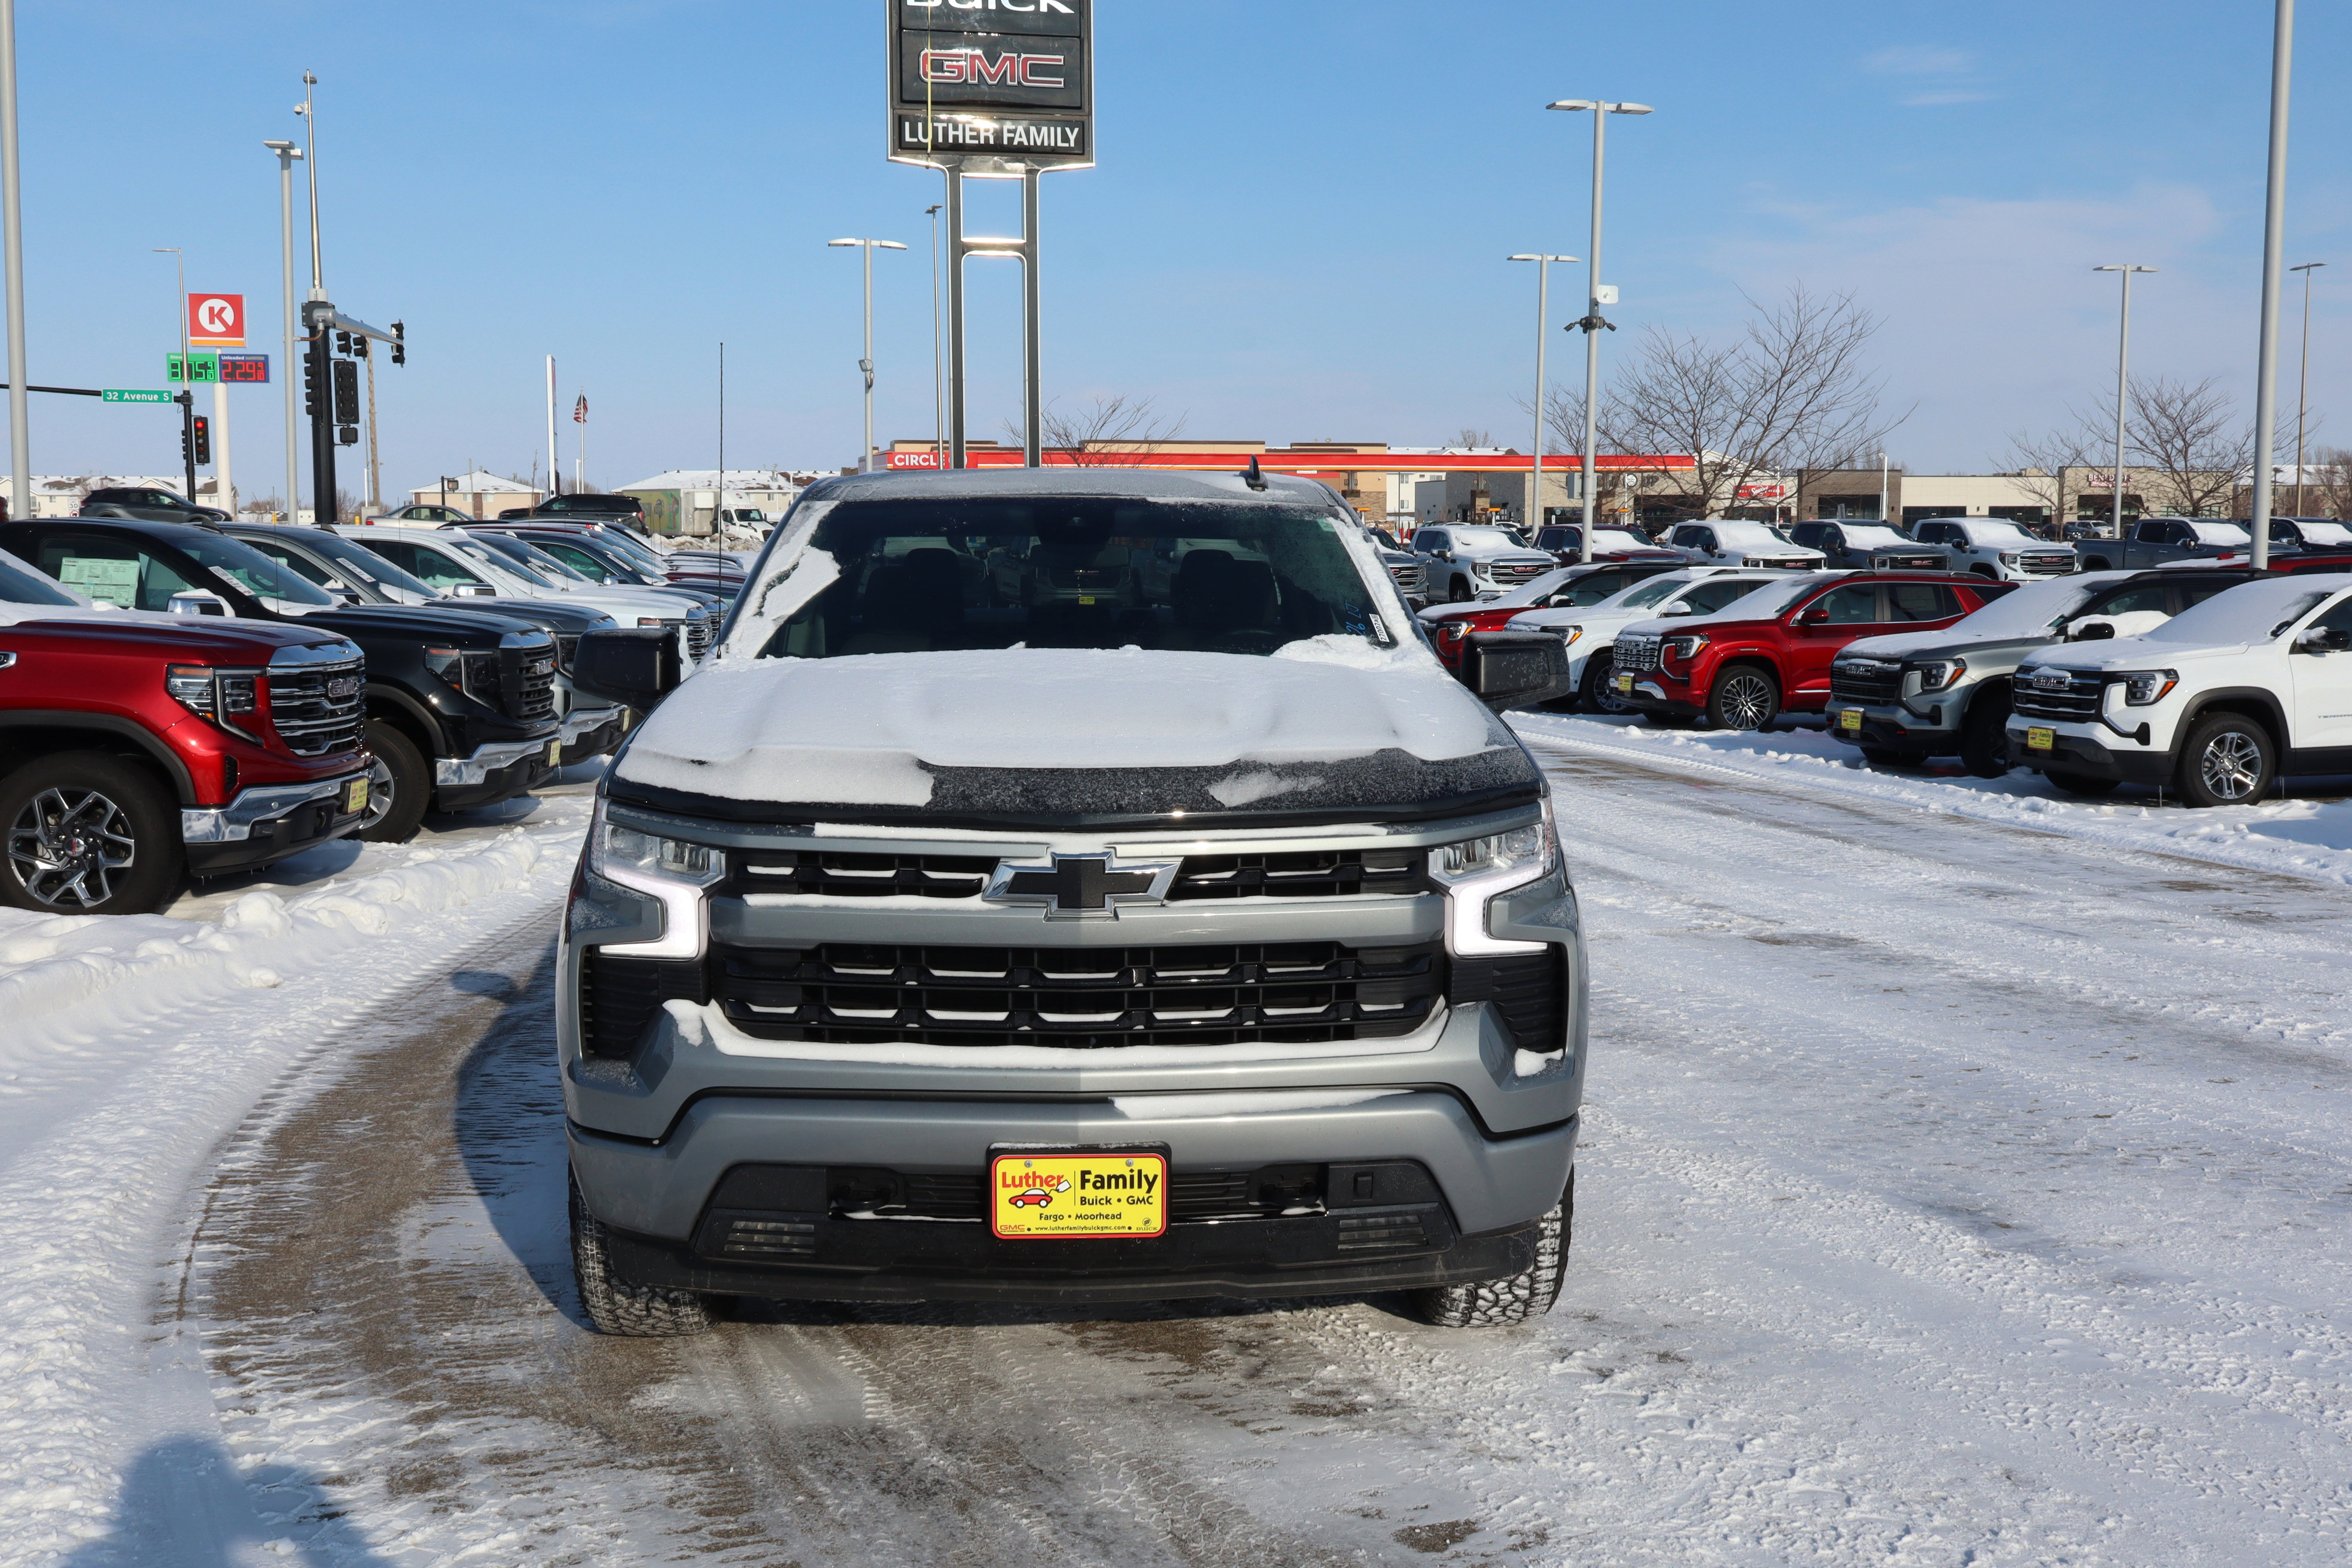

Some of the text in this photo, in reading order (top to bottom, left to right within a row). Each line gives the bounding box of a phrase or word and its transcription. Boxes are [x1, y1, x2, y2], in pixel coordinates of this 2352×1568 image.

[919, 49, 1065, 88] GMC
[904, 121, 1079, 147] LUTHER FAMILY
[208, 306, 232, 330] K
[106, 392, 118, 401] 32
[123, 392, 159, 401] Avenue
[1846, 665, 1872, 675] GMC
[2034, 676, 2065, 688] GMC
[1002, 1168, 1158, 1194] Luther Family
[1080, 1196, 1153, 1205] Buick GMC
[1039, 1212, 1122, 1221] Fargo Moorhead
